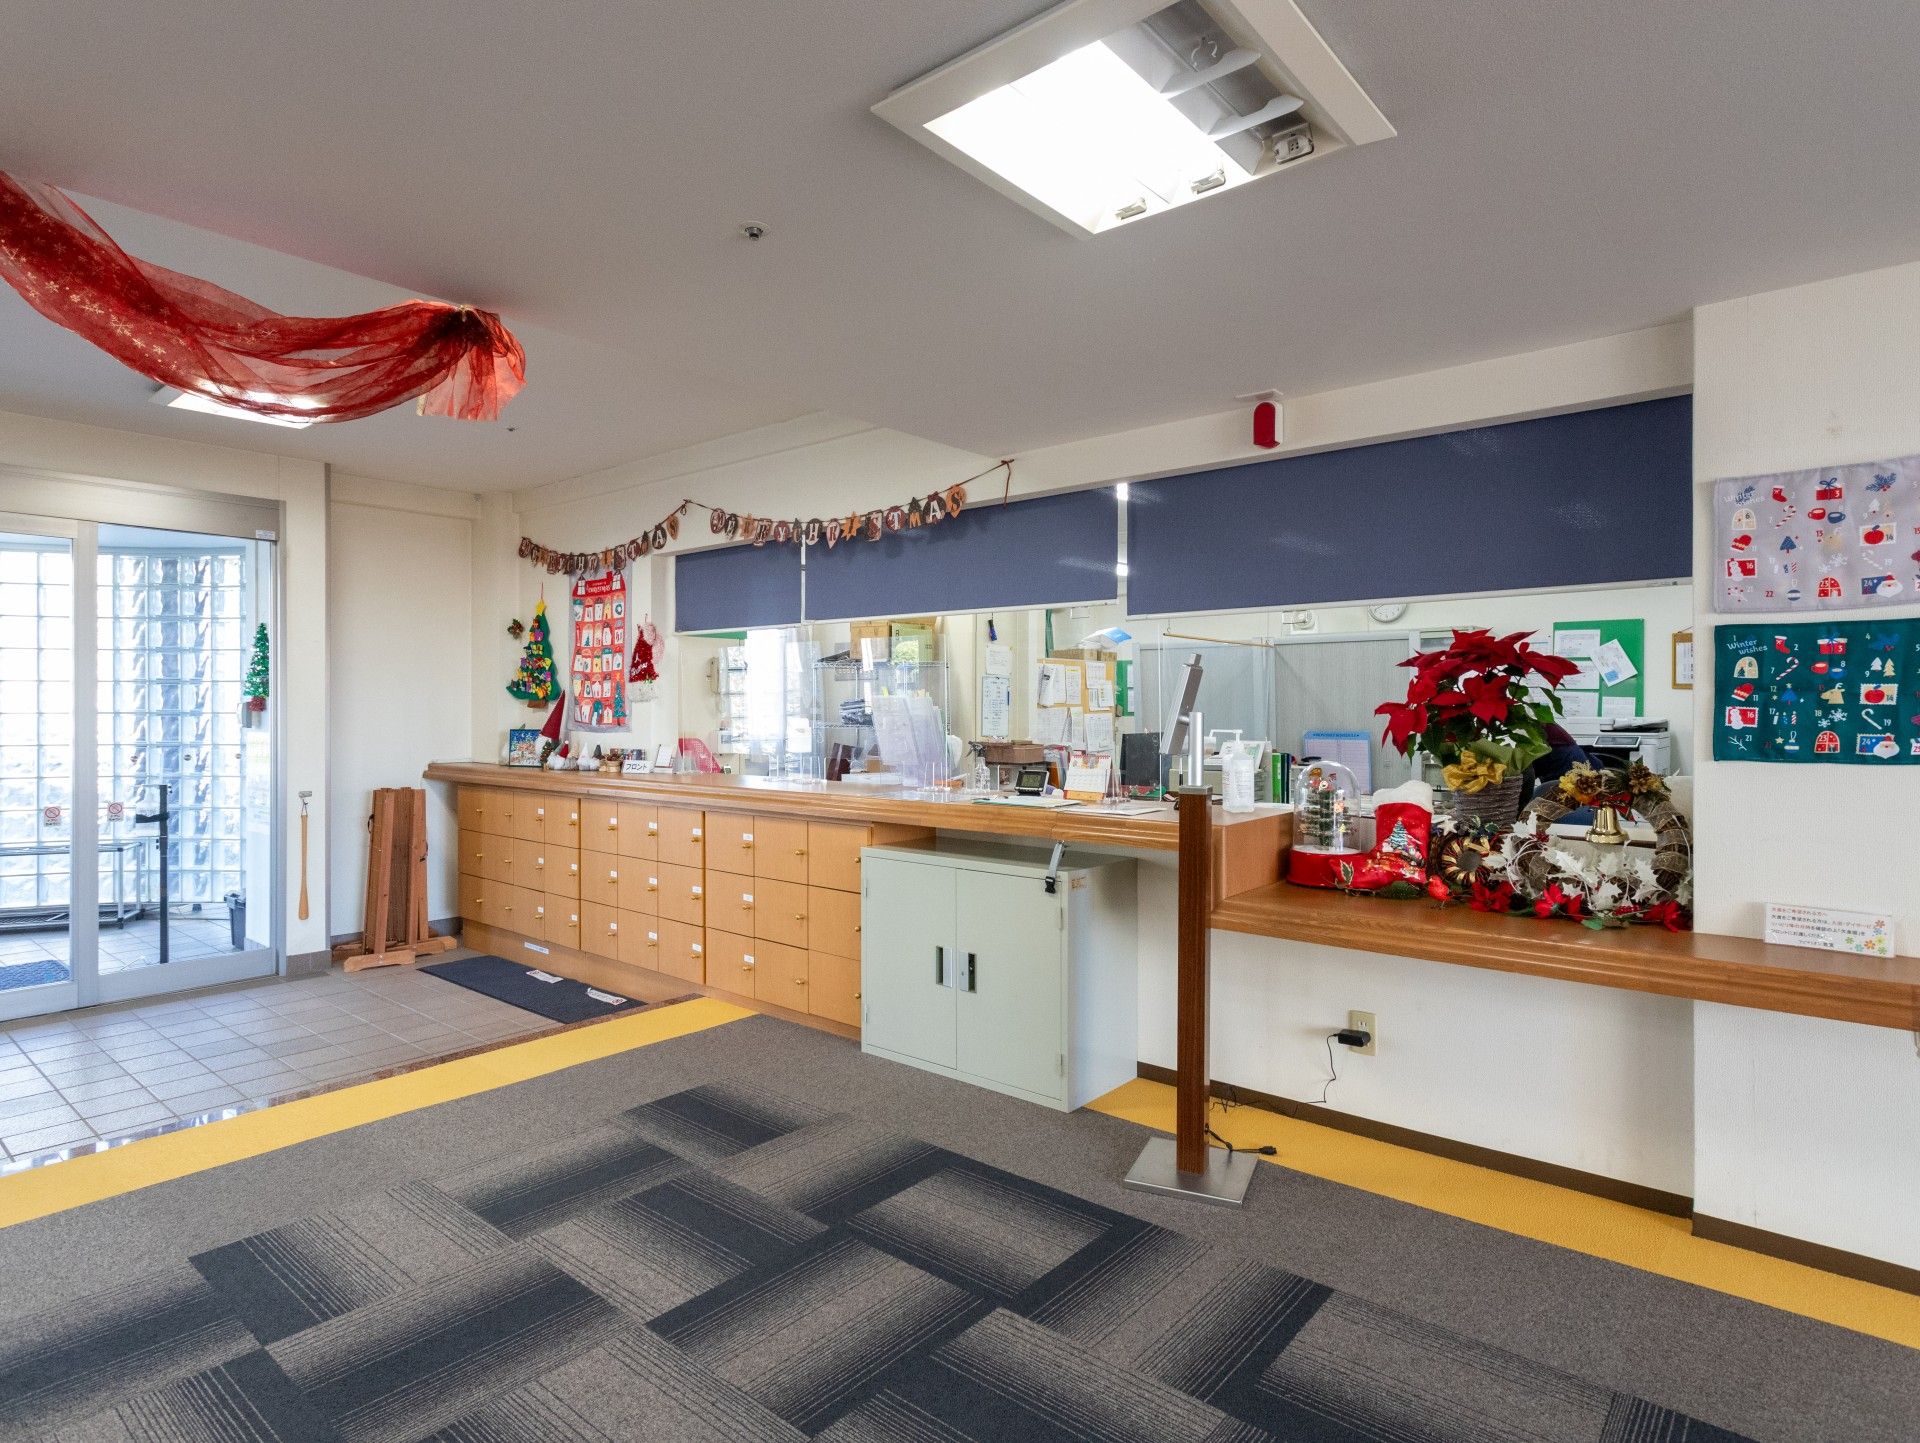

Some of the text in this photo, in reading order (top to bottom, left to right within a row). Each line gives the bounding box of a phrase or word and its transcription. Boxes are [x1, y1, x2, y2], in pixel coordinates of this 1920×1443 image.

[1726, 640, 1757, 650] Winter
[1738, 645, 1768, 655] wishes
[626, 763, 647, 771] フロント
